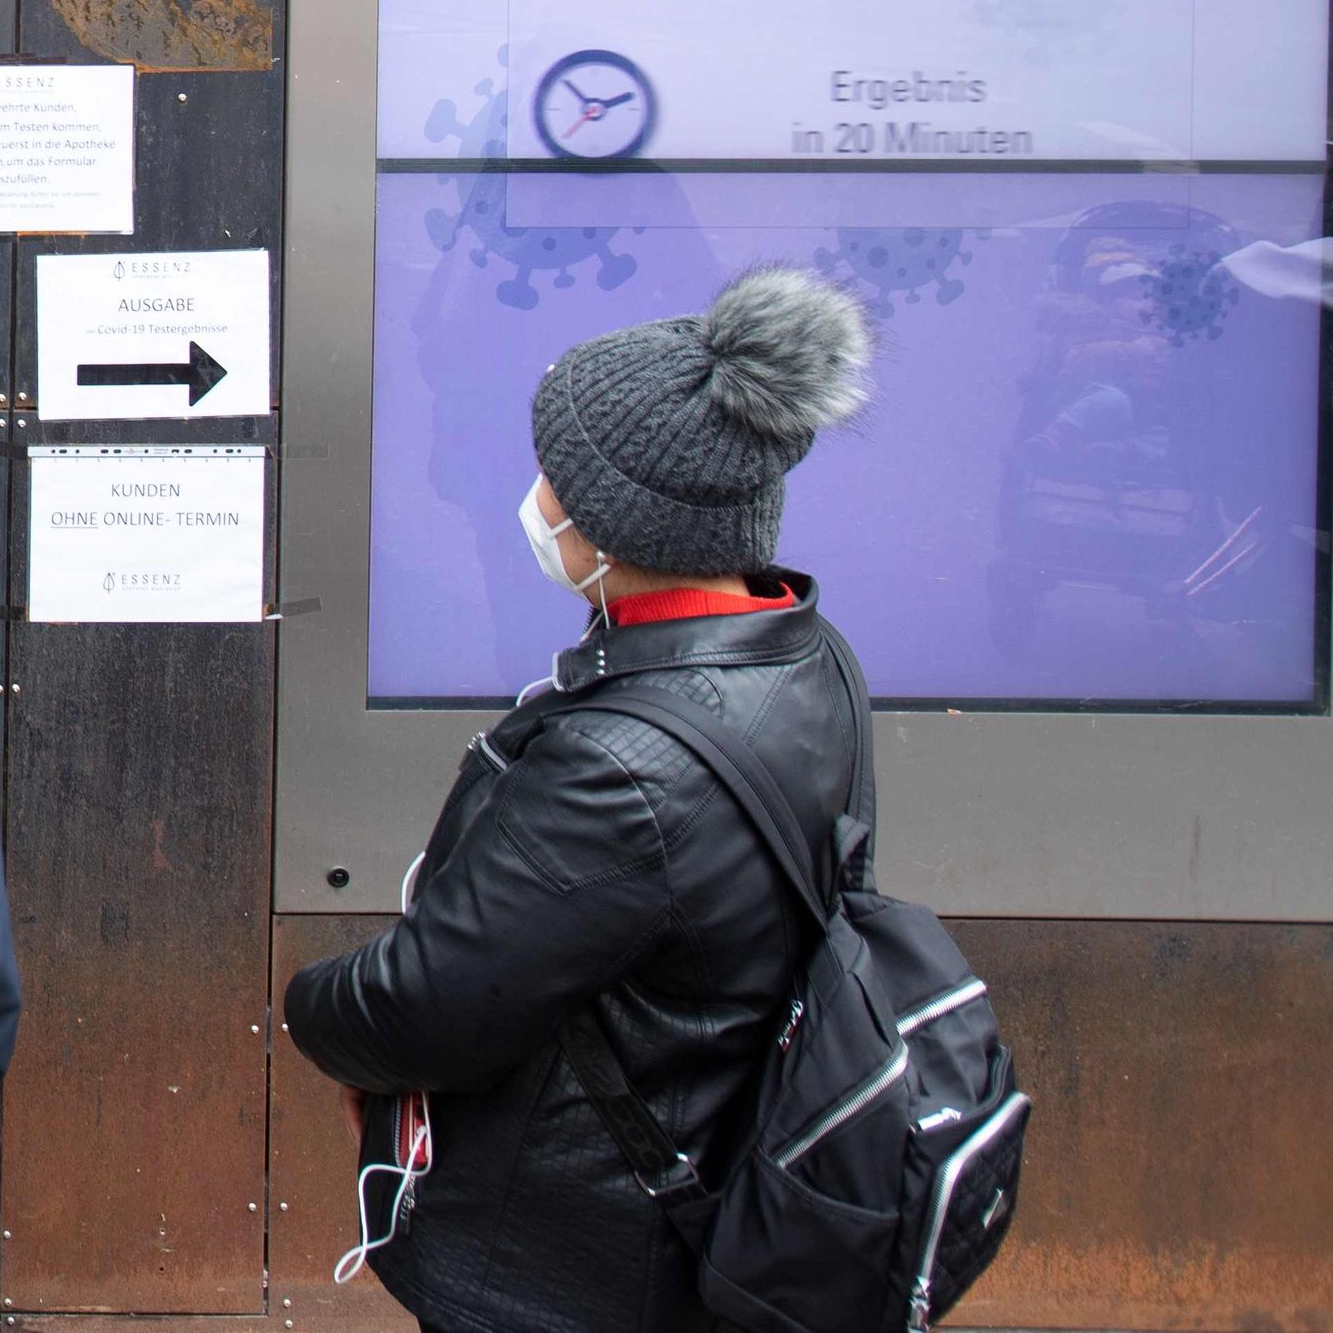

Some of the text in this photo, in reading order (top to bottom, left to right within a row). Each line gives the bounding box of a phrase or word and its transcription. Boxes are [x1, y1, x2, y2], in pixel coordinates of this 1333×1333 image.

[830, 69, 988, 112] Ergebnis
[34, 103, 77, 113] Kunden,
[14, 122, 49, 132] Testen
[52, 122, 102, 133] kommen,
[792, 122, 1033, 155] in 20 Minuten
[32, 140, 42, 149] in
[45, 140, 61, 149] die
[64, 140, 116, 150] Apotheke
[27, 157, 45, 166] das
[48, 157, 97, 166] Formular
[132, 262, 190, 273] ESSENZ
[118, 298, 195, 312] AUSGABE
[97, 324, 145, 335] Covid-19
[149, 324, 228, 335] Testergebnisse
[111, 483, 181, 497] KUNDEN
[51, 512, 239, 526] OHNE ONLINE- TERMIN
[122, 574, 181, 586] ESSENZ
